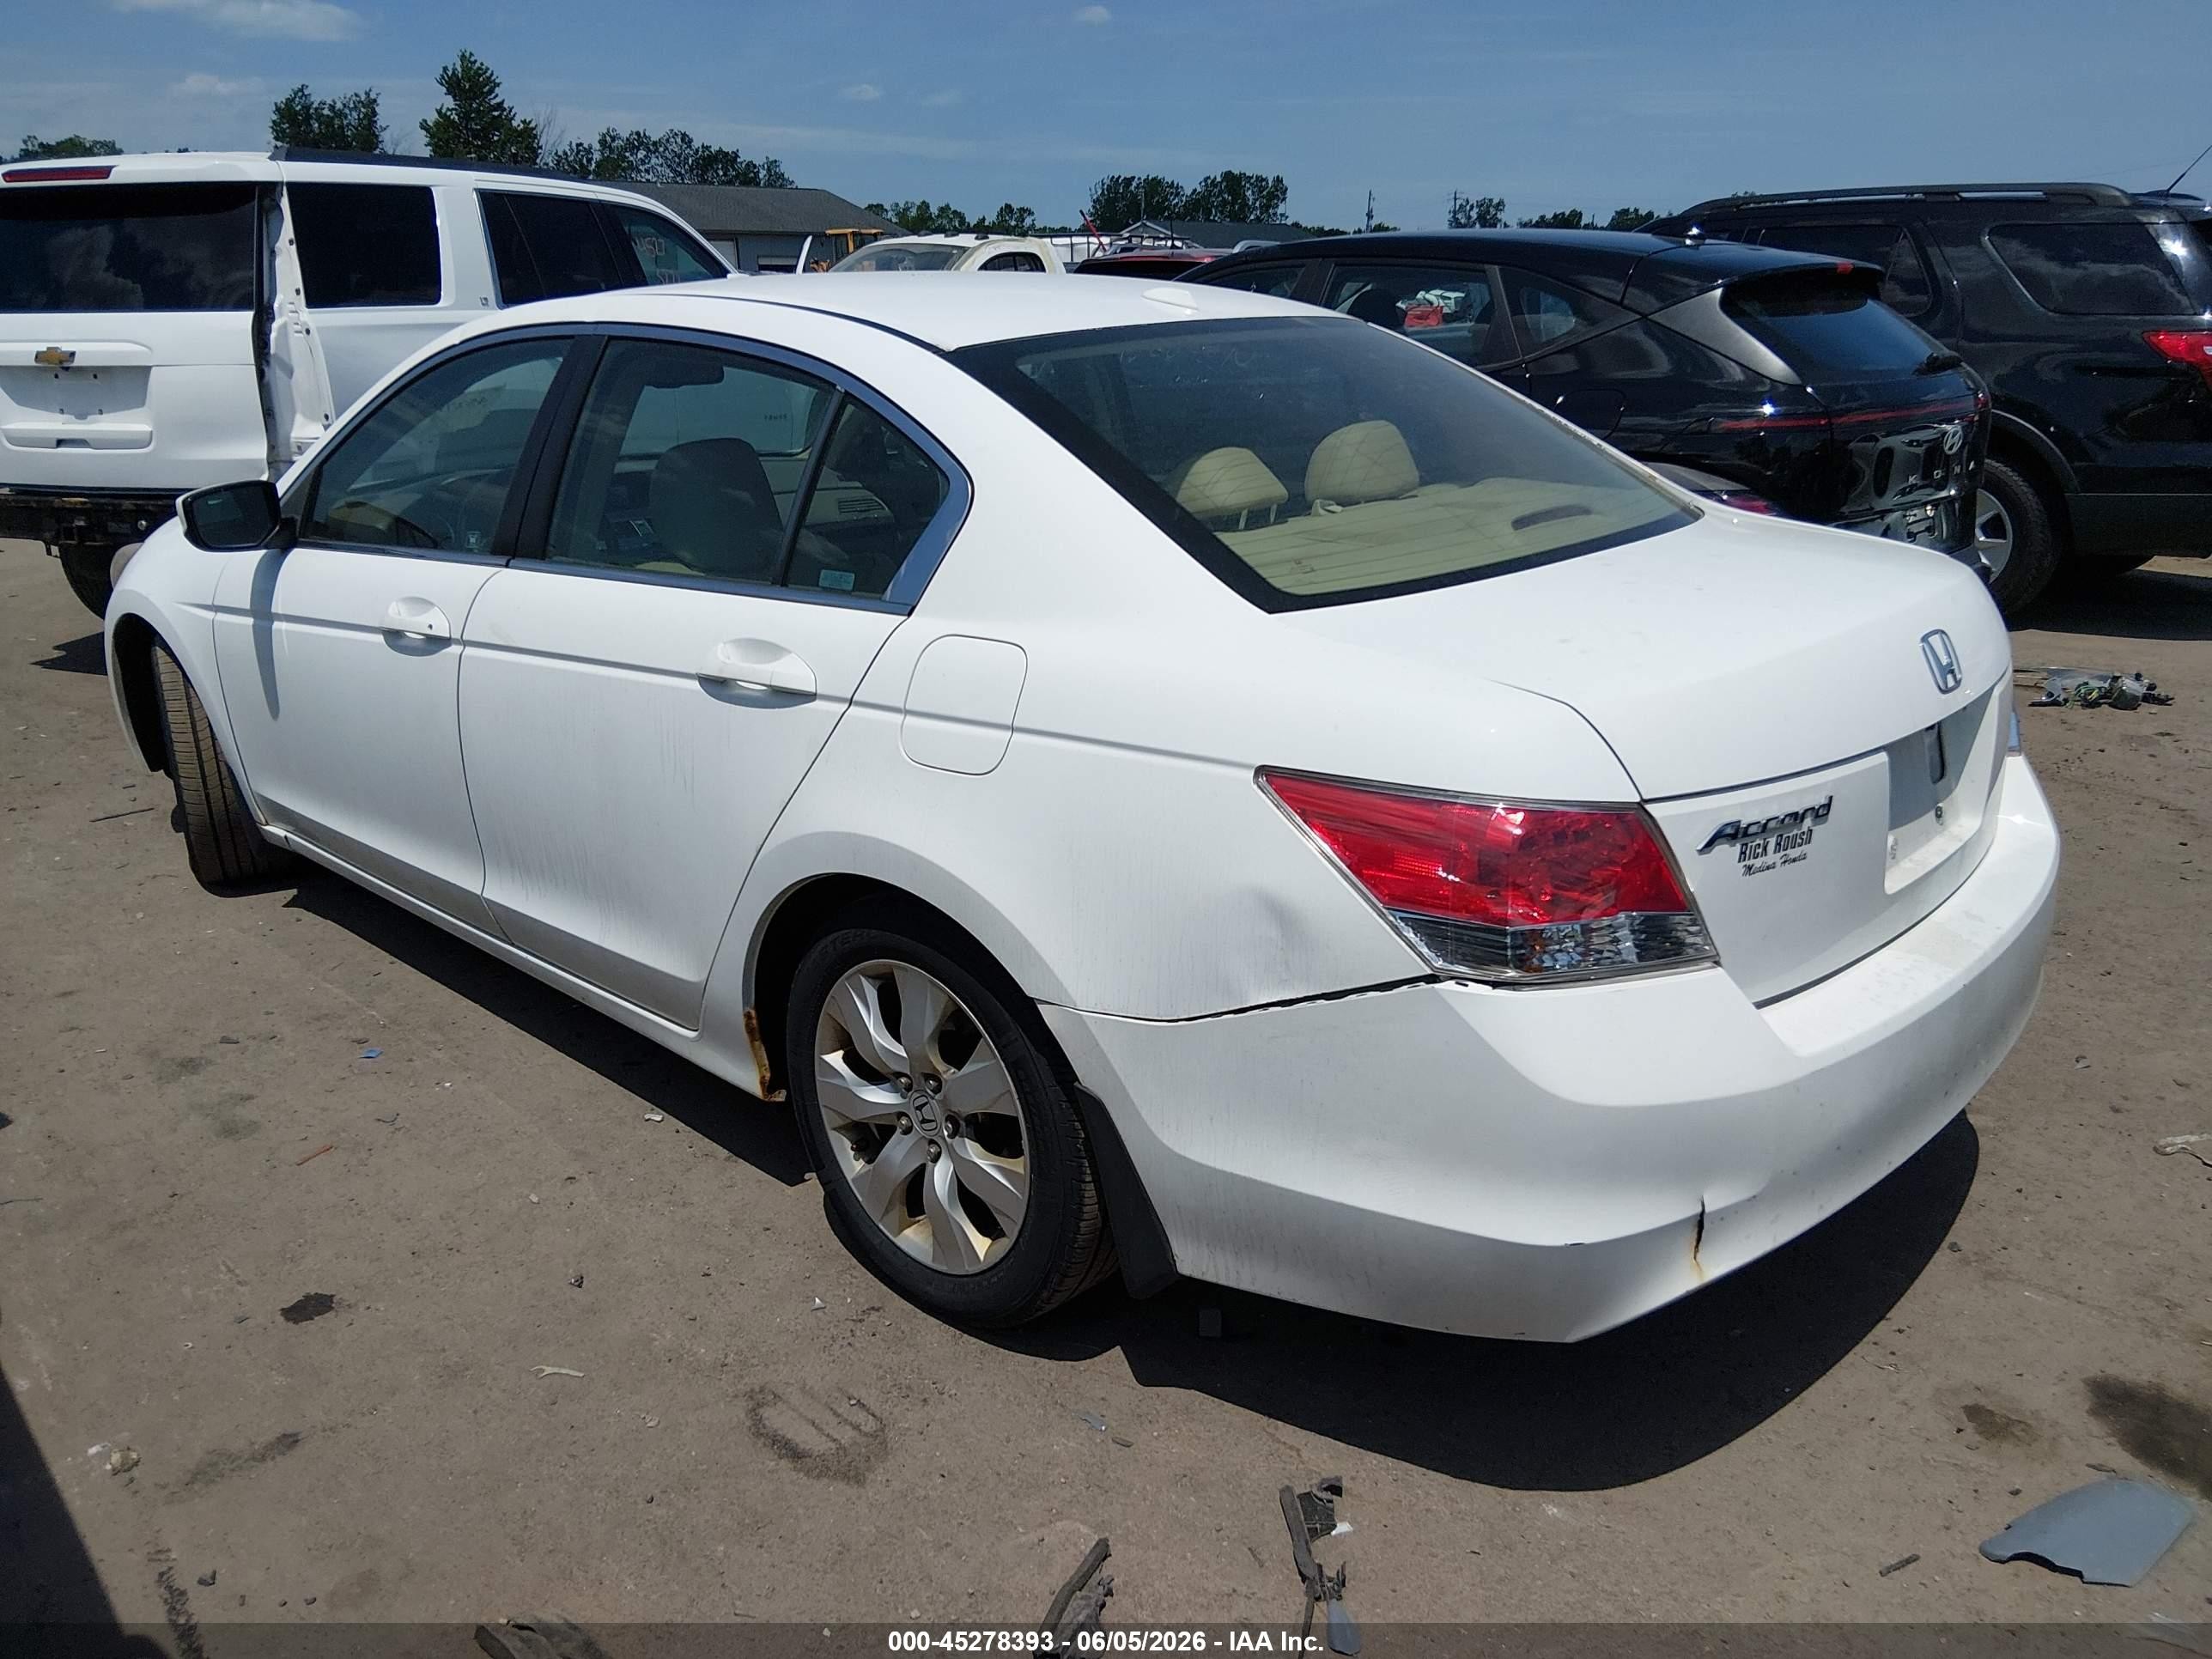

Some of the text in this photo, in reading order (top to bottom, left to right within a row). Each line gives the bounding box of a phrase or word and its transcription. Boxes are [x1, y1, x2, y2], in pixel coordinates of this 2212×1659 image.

[1908, 460, 1975, 483] KONA
[1696, 795, 1833, 854] Accord
[1737, 827, 1813, 863] Rick Roush
[1741, 850, 1808, 877] Medina Honda
